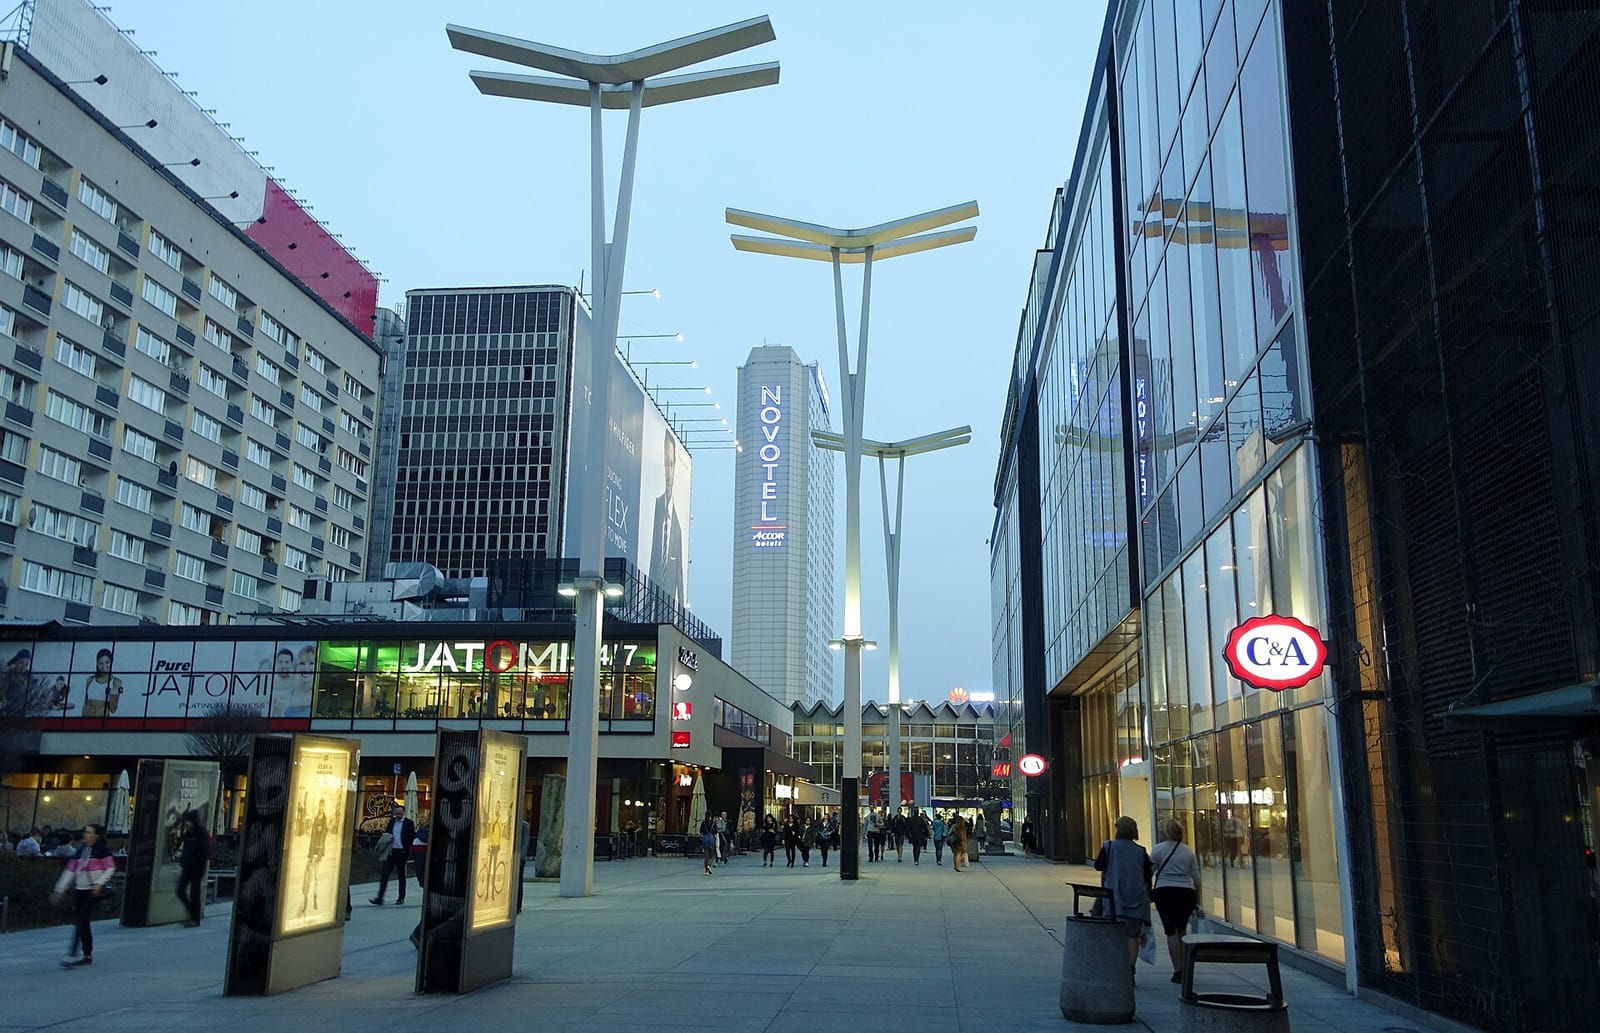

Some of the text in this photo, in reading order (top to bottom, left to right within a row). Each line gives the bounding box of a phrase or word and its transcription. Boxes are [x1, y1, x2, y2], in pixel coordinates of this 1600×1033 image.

[760, 385, 782, 521] NOVOTEL
[606, 484, 629, 535] LEX
[155, 660, 191, 671] Pure
[405, 640, 568, 673] JATOMI
[1246, 636, 1310, 666] C&A
[141, 673, 269, 697] JATOMI
